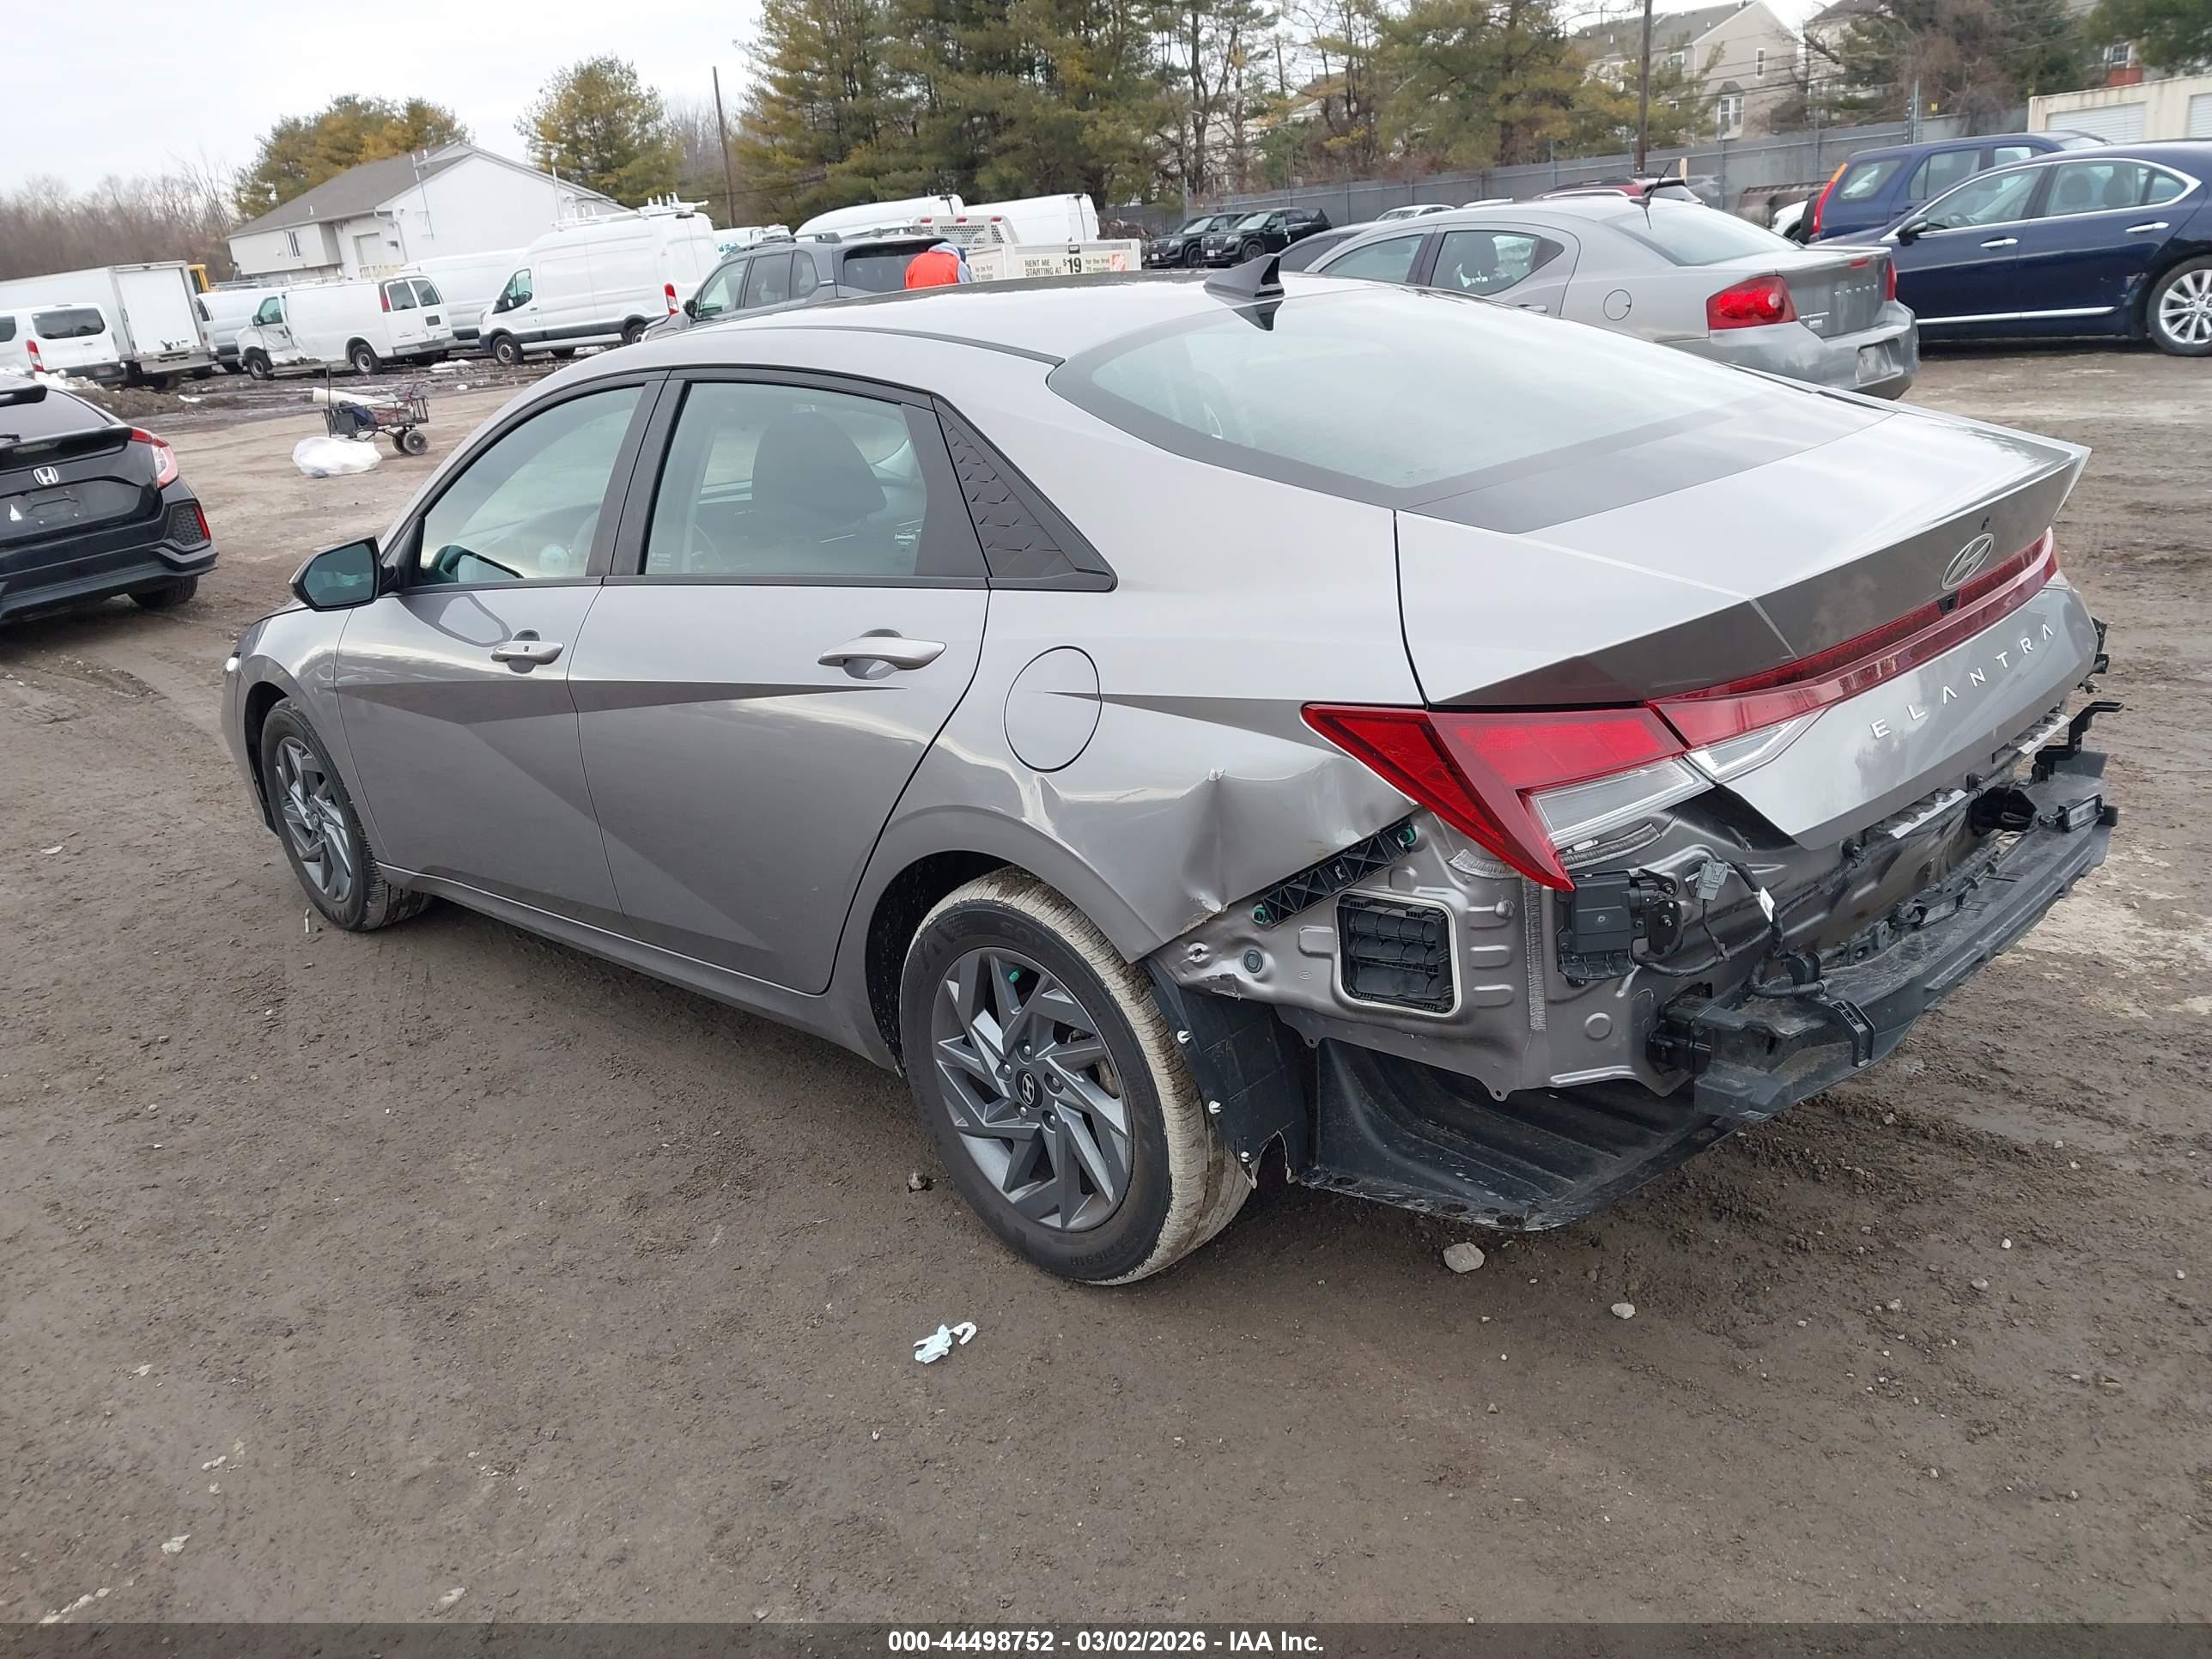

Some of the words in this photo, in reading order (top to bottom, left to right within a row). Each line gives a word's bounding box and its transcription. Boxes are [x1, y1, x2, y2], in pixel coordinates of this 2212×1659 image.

[1025, 267, 1054, 276] STARTING
[1054, 266, 1062, 275] AT
[1063, 258, 1082, 273] $19
[1869, 623, 2054, 739] ELANTRA
